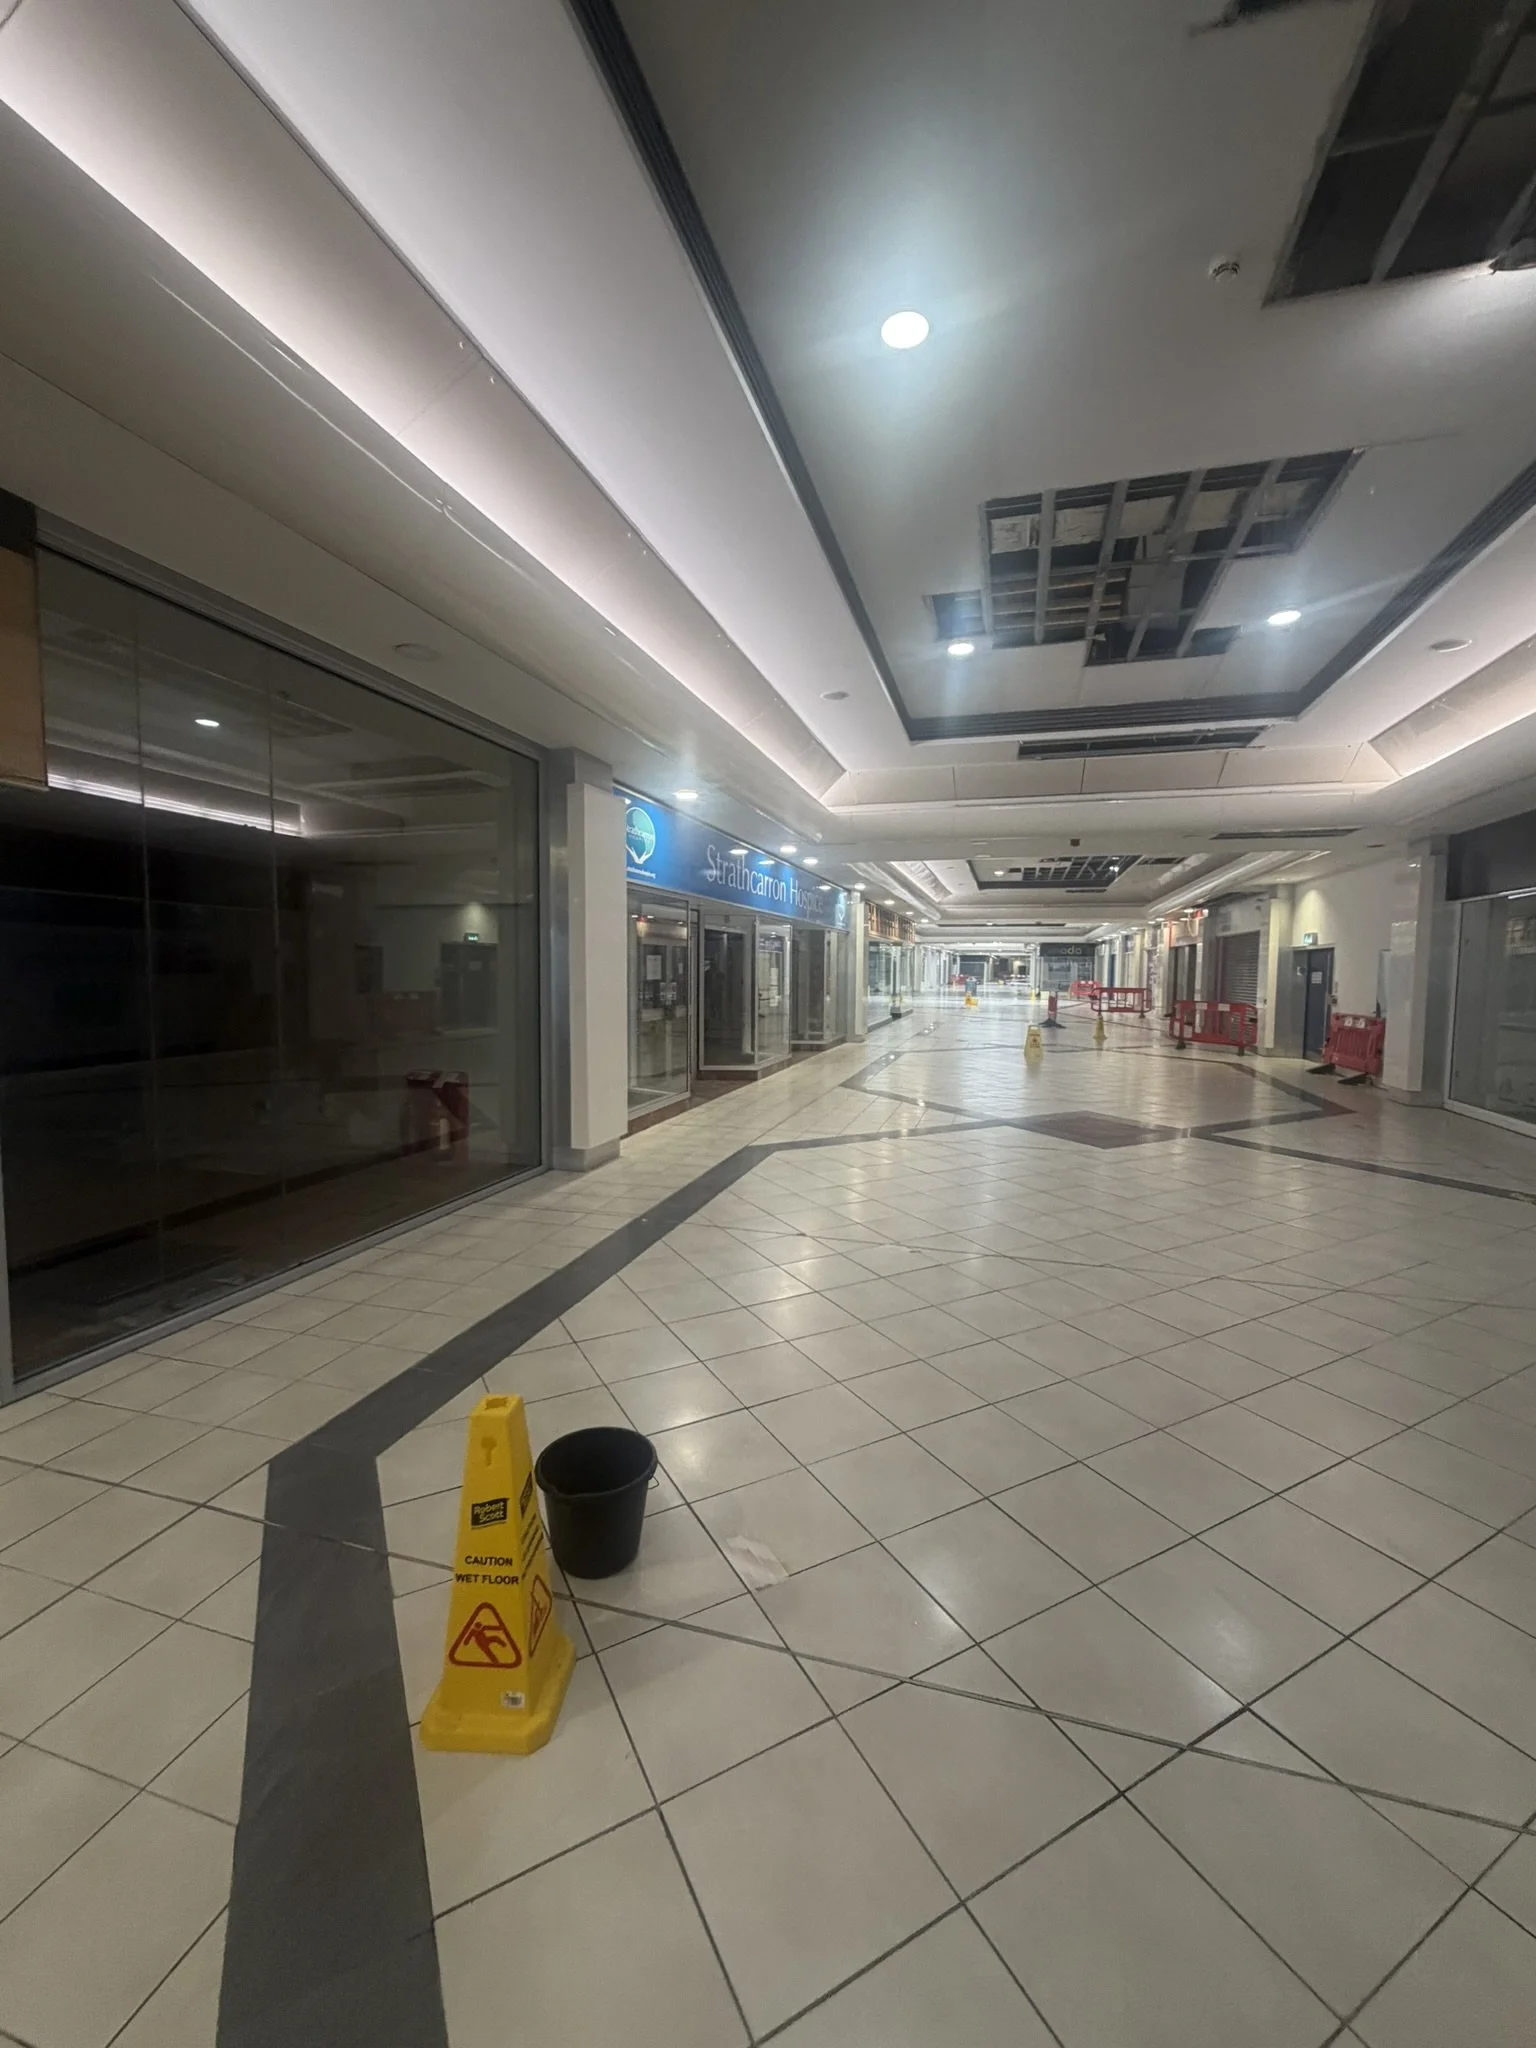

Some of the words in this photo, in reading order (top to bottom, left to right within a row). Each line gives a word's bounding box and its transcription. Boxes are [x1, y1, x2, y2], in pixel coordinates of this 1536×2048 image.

[706, 844, 786, 902] Strathcarron
[790, 876, 823, 918] Hospice
[473, 1502, 504, 1514] Robert
[479, 1510, 504, 1523] Scott
[464, 1555, 513, 1566] CAUTION
[456, 1573, 479, 1583] WET
[481, 1575, 519, 1585] FLOOR
